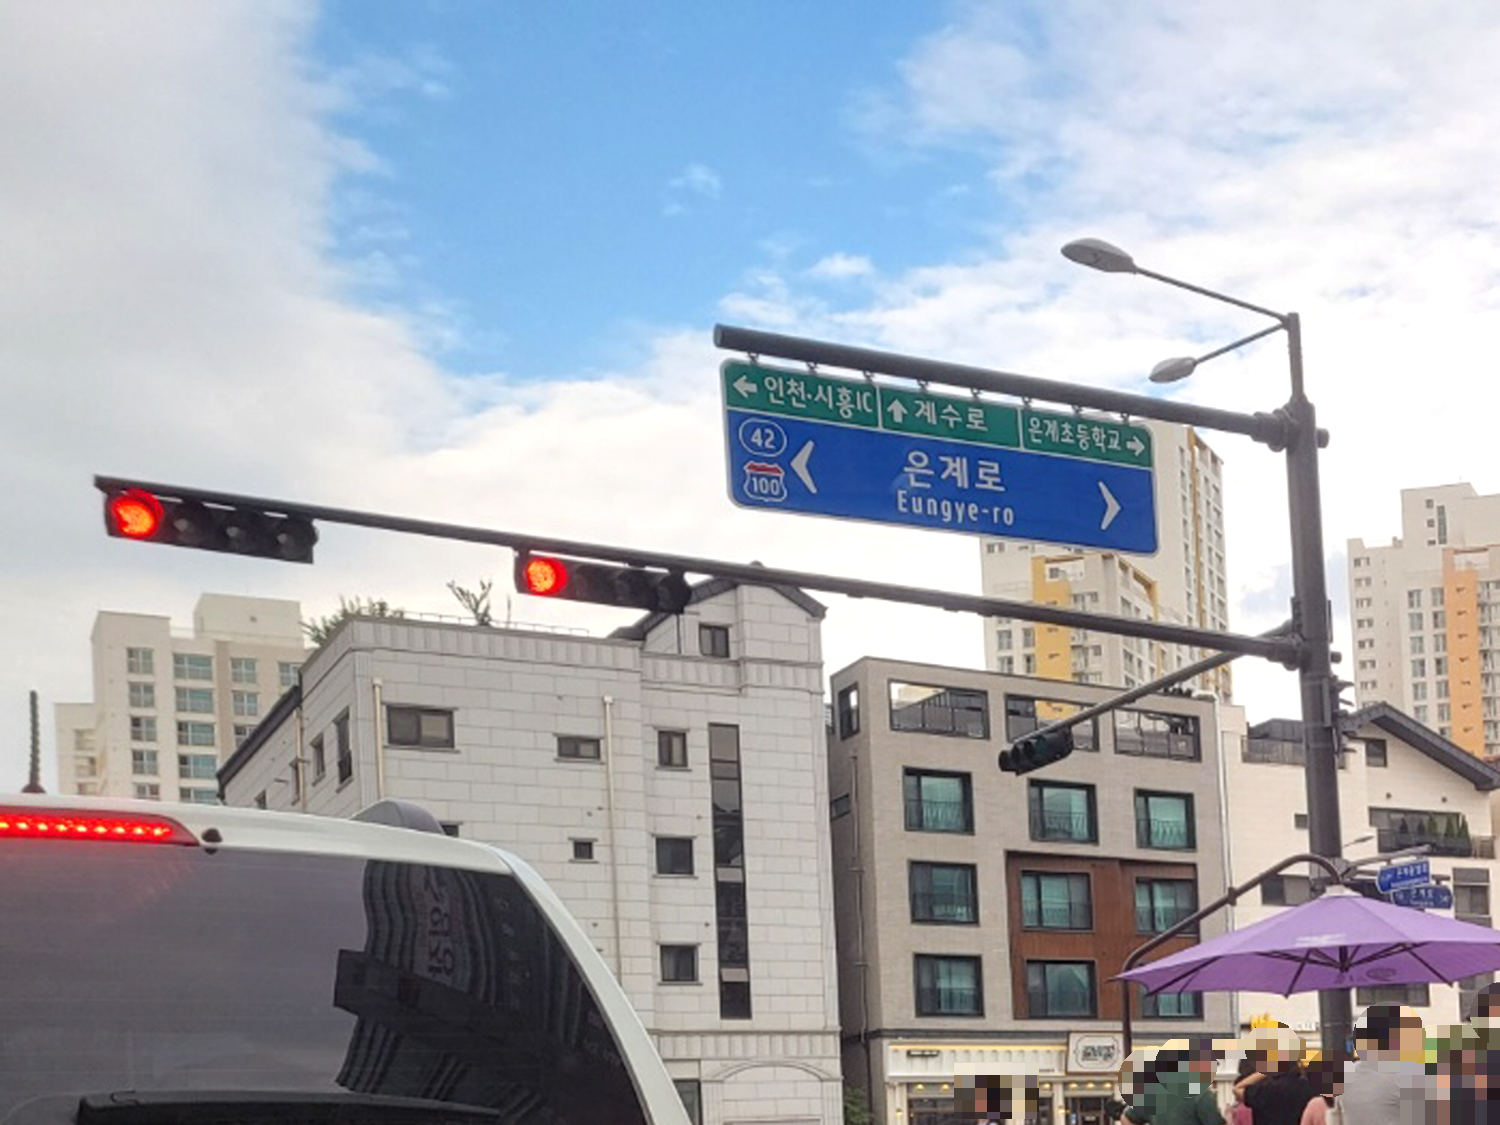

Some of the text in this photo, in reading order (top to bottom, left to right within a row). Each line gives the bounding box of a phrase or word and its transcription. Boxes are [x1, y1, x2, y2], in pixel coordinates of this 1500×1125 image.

[914, 400, 989, 432] 계수로
[750, 427, 776, 450] 42
[1028, 417, 1121, 452] 은계초등학교
[751, 476, 781, 496] 100
[903, 450, 1006, 492] 은계로
[897, 489, 1015, 526] Eungye-ro
